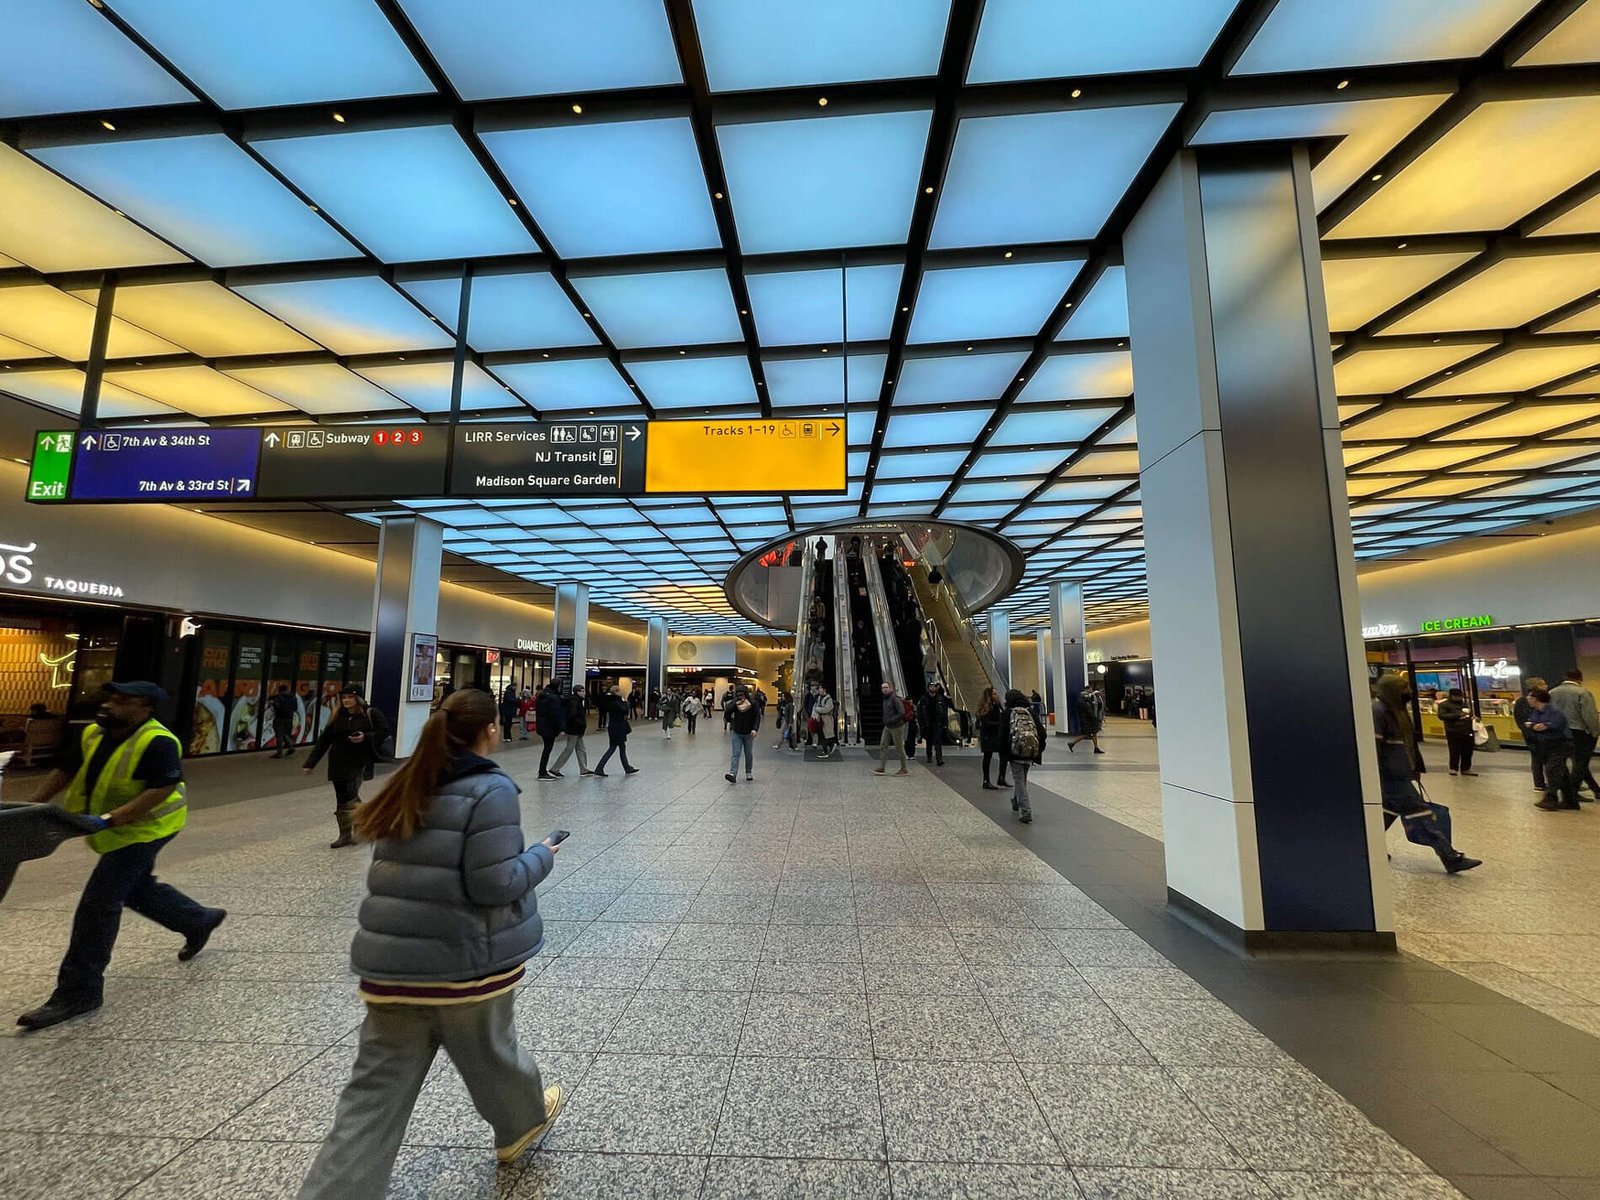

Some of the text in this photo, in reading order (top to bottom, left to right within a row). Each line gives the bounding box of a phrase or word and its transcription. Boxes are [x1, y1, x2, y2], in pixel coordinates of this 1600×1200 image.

[465, 431, 546, 443] LIRR Services
[703, 425, 744, 437] Tracks
[122, 434, 211, 447] 7th Av & 34th St
[325, 433, 371, 446] Subway
[535, 450, 597, 463] NJ Transit
[138, 480, 230, 492] 7th Av & 33rd St
[475, 474, 617, 488] Madison Square Garden
[31, 481, 65, 497] Exit
[44, 576, 124, 597] TAQUERIA
[1421, 620, 1441, 632] ICE
[1444, 615, 1491, 630] CREAM
